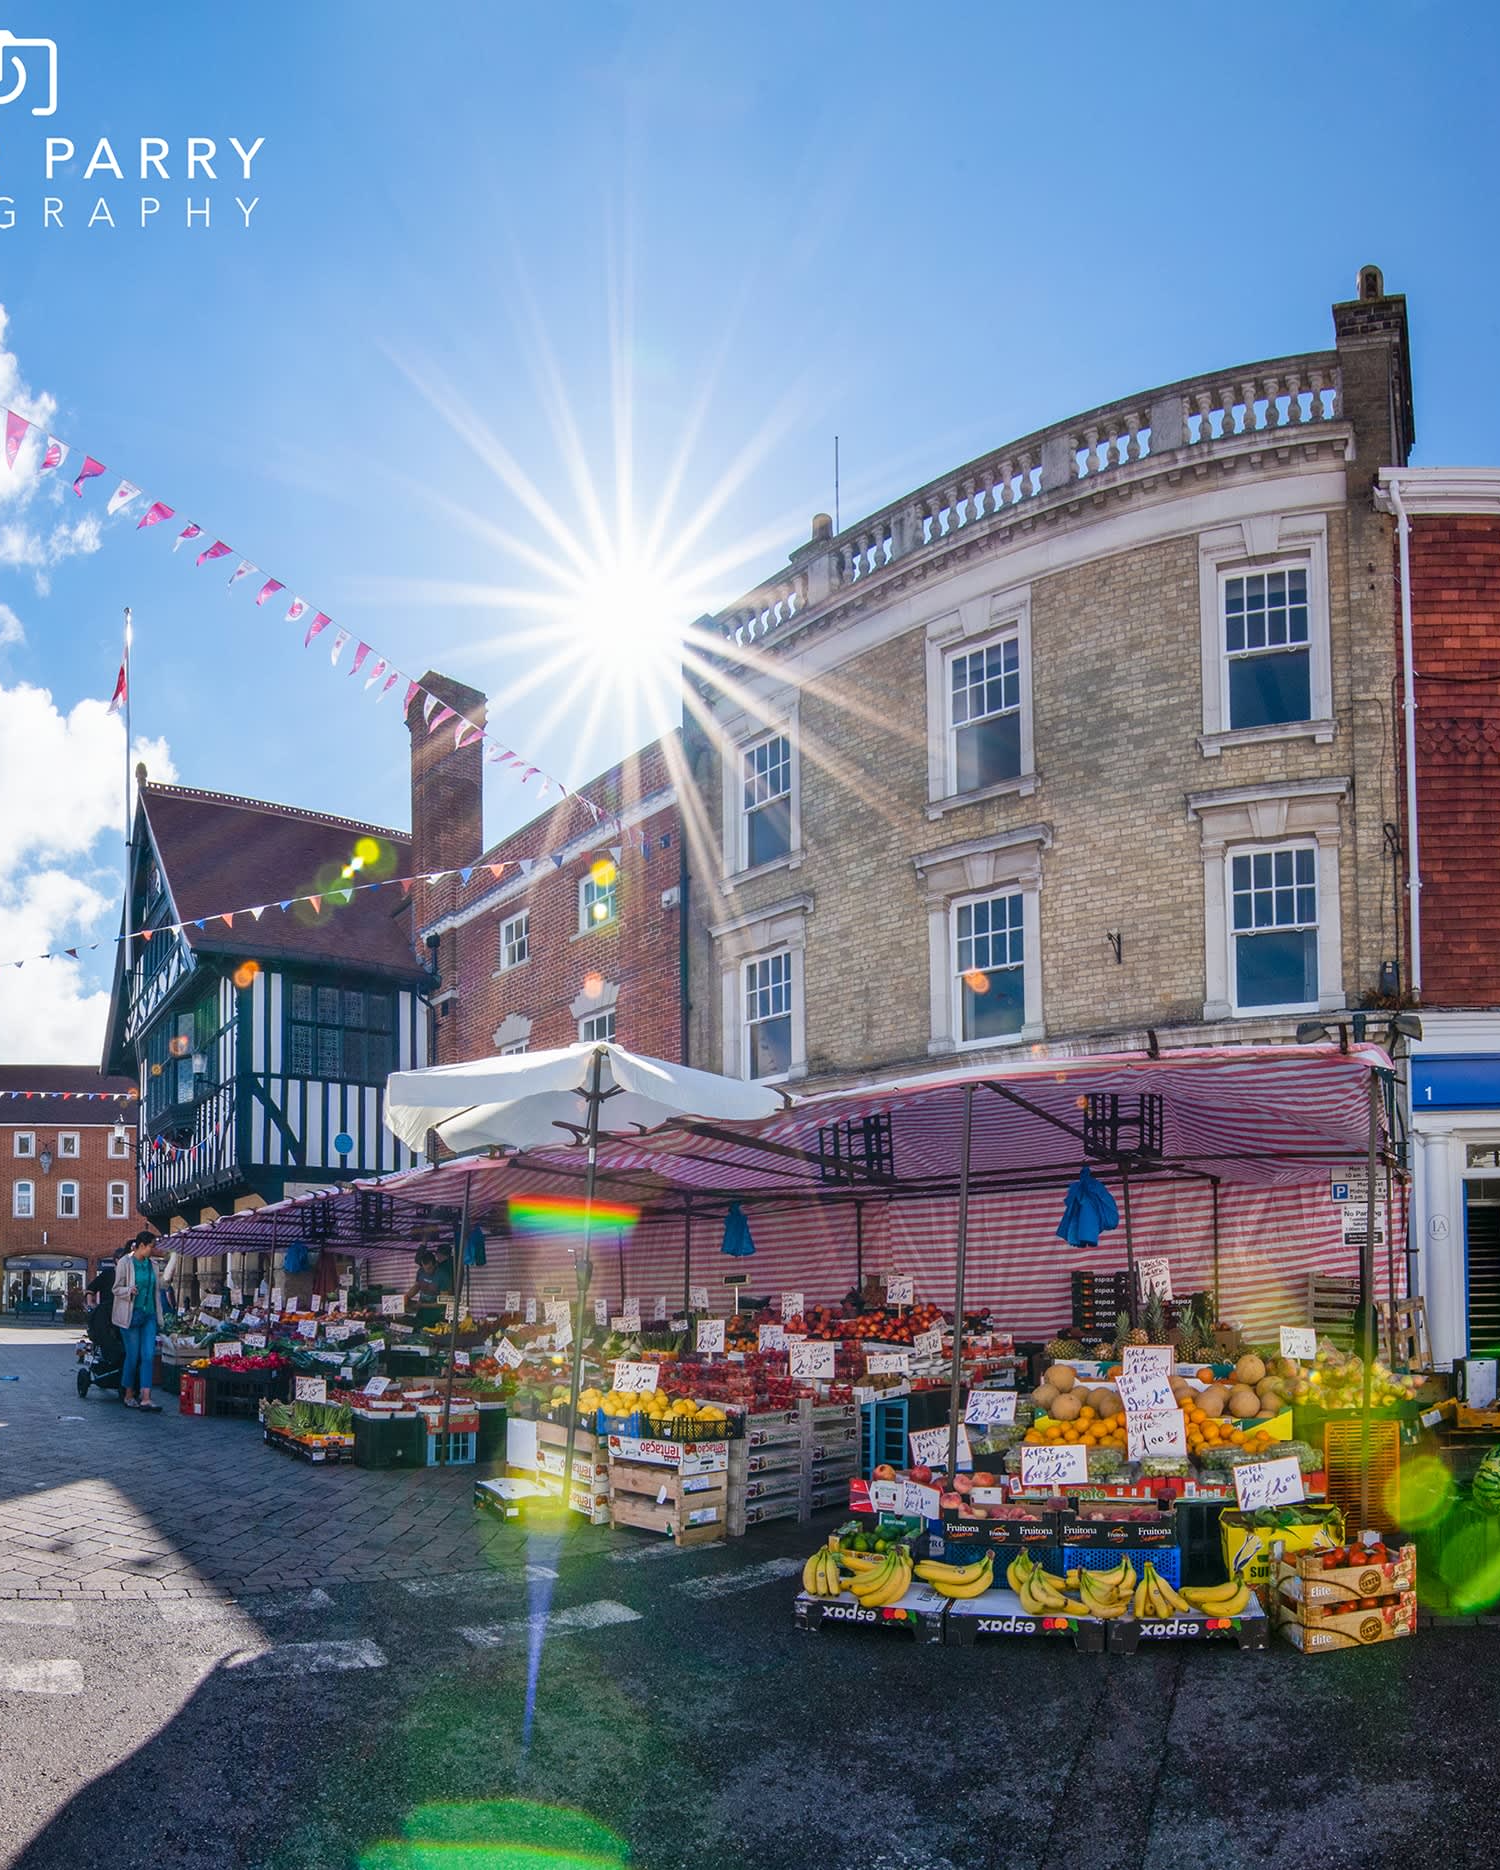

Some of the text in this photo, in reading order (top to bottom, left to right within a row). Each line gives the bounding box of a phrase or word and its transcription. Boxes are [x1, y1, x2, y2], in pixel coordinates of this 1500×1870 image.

[1425, 1086, 1432, 1101] 1
[1336, 1186, 1346, 1198] P
[946, 1523, 981, 1533] Fruitona
[1019, 1526, 1053, 1537] Fruitona
[1063, 1525, 1098, 1536] Fruitona
[1138, 1527, 1172, 1537] Fruitona
[1311, 1586, 1332, 1598] Elite
[823, 1605, 877, 1622] espax
[976, 1617, 1037, 1634] espax
[1139, 1620, 1200, 1638] espax
[1311, 1634, 1333, 1646] Elite
